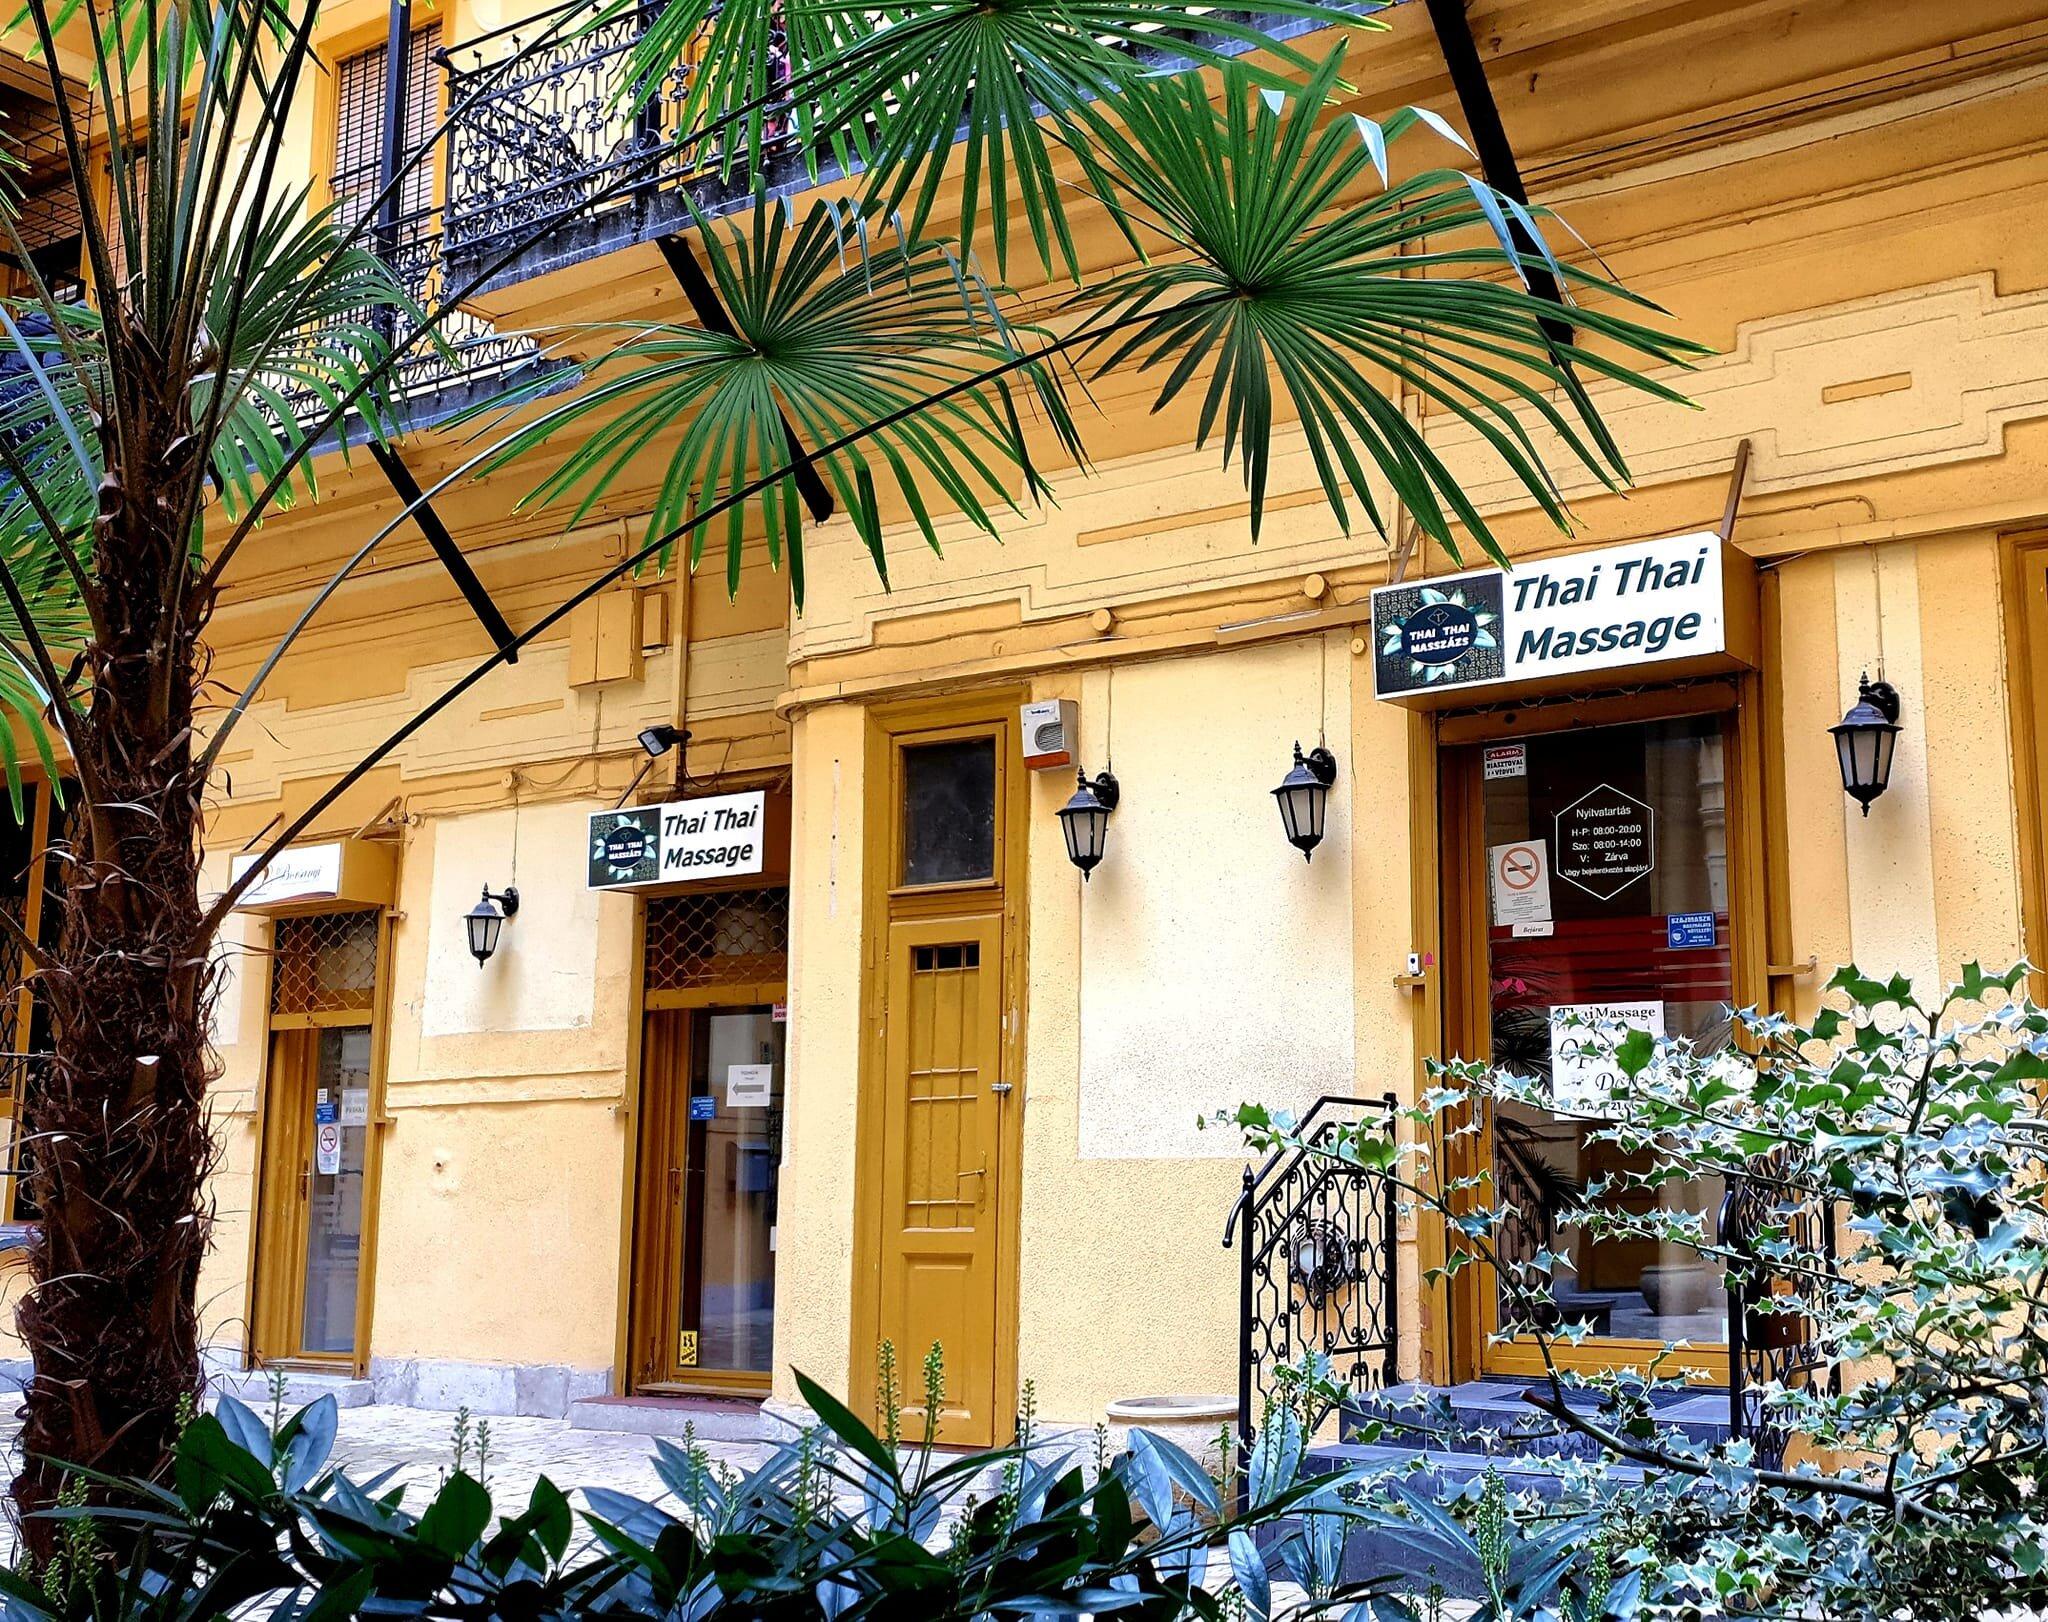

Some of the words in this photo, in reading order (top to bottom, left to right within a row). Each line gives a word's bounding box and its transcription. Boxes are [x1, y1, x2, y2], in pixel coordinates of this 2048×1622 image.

[1513, 566, 1600, 613] Thai
[1614, 547, 1708, 597] Thai
[1409, 628, 1436, 641] THAI
[1442, 623, 1470, 636] THAI
[1515, 612, 1700, 665] Massage
[1410, 636, 1469, 654] MASSZÁZS
[1490, 750, 1520, 758] ALARM
[664, 810, 708, 837] Thai
[713, 804, 759, 832] Thai
[1576, 805, 1632, 820] Nyitvatartás
[1571, 827, 1591, 837] H-P:
[1593, 824, 1642, 836] 08:00-20:00
[1571, 842, 1590, 851] Szo:
[1593, 838, 1642, 850] 08:00-14:00
[664, 843, 753, 870] Massage
[1579, 854, 1590, 863] V:
[1604, 852, 1629, 862] Zárva
[1564, 868, 1581, 877] Vagy
